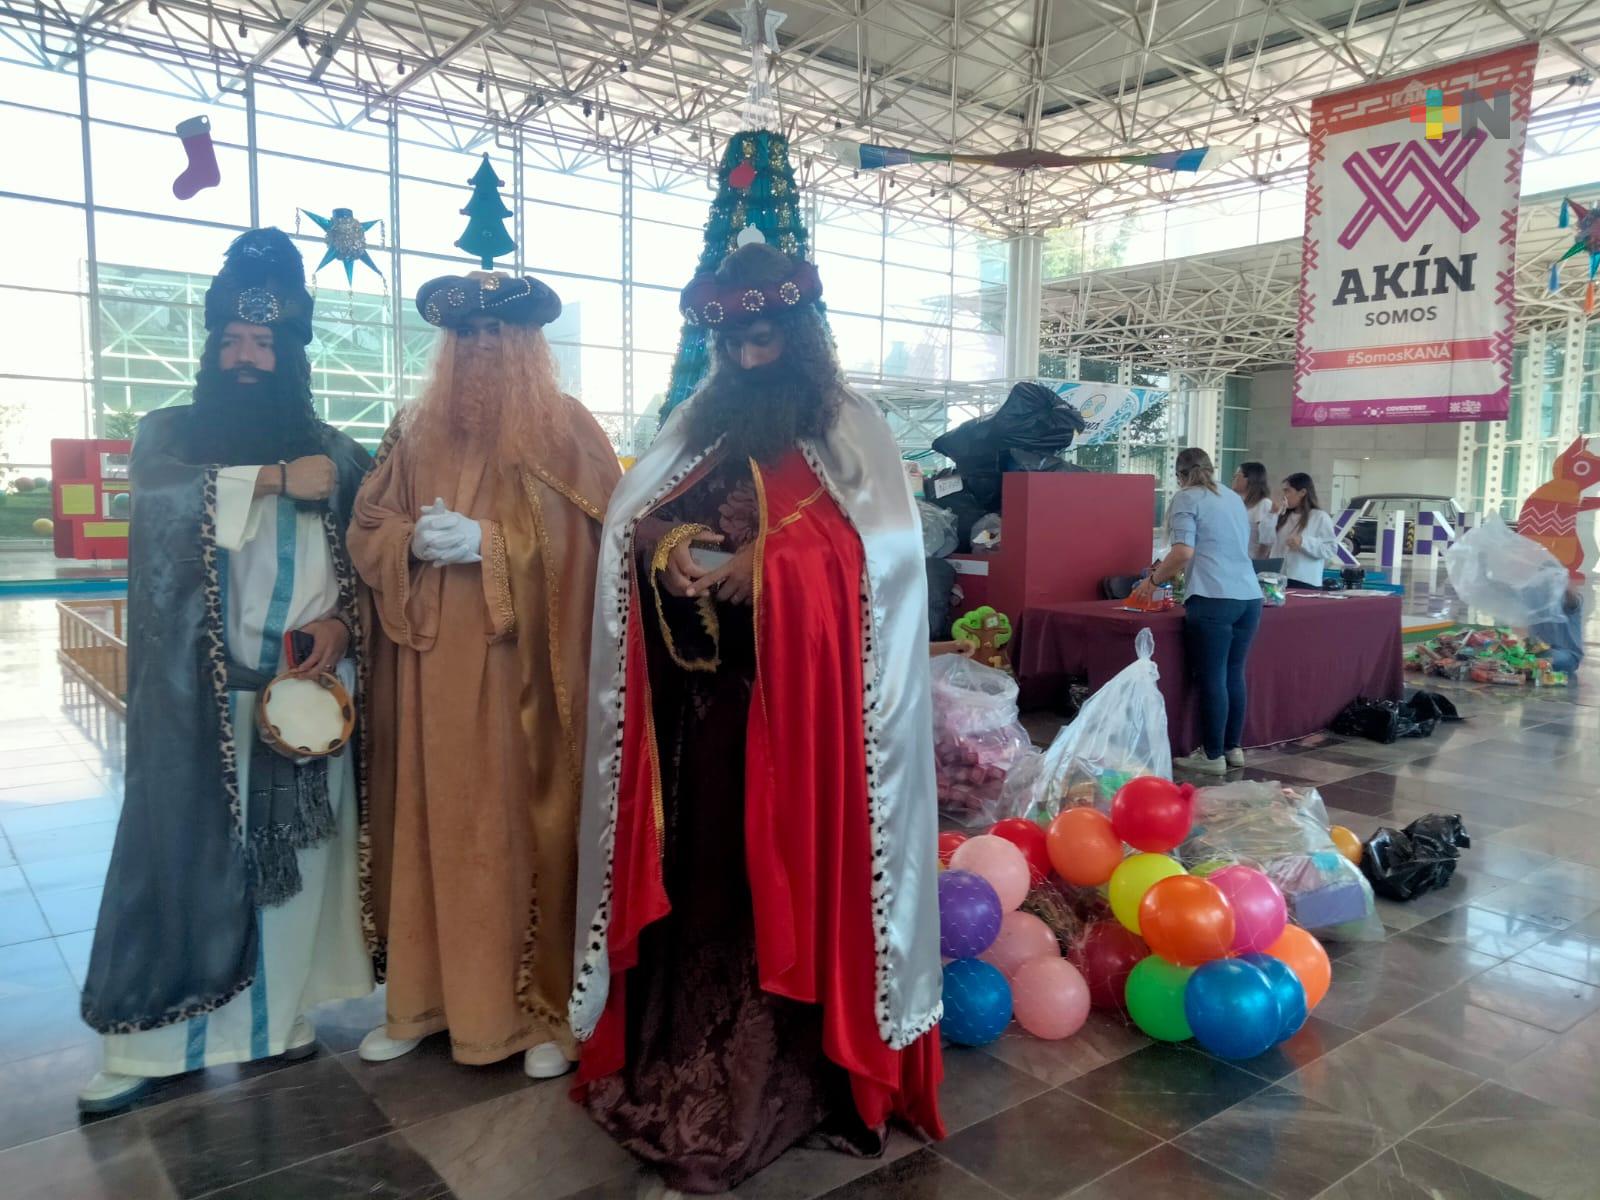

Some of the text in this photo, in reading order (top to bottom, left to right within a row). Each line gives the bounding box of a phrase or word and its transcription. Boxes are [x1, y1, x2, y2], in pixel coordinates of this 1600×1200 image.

[1331, 244, 1478, 306] AKÍN
[1365, 306, 1438, 327] SOMOS
[1347, 342, 1450, 365] #SomosKANÁ
